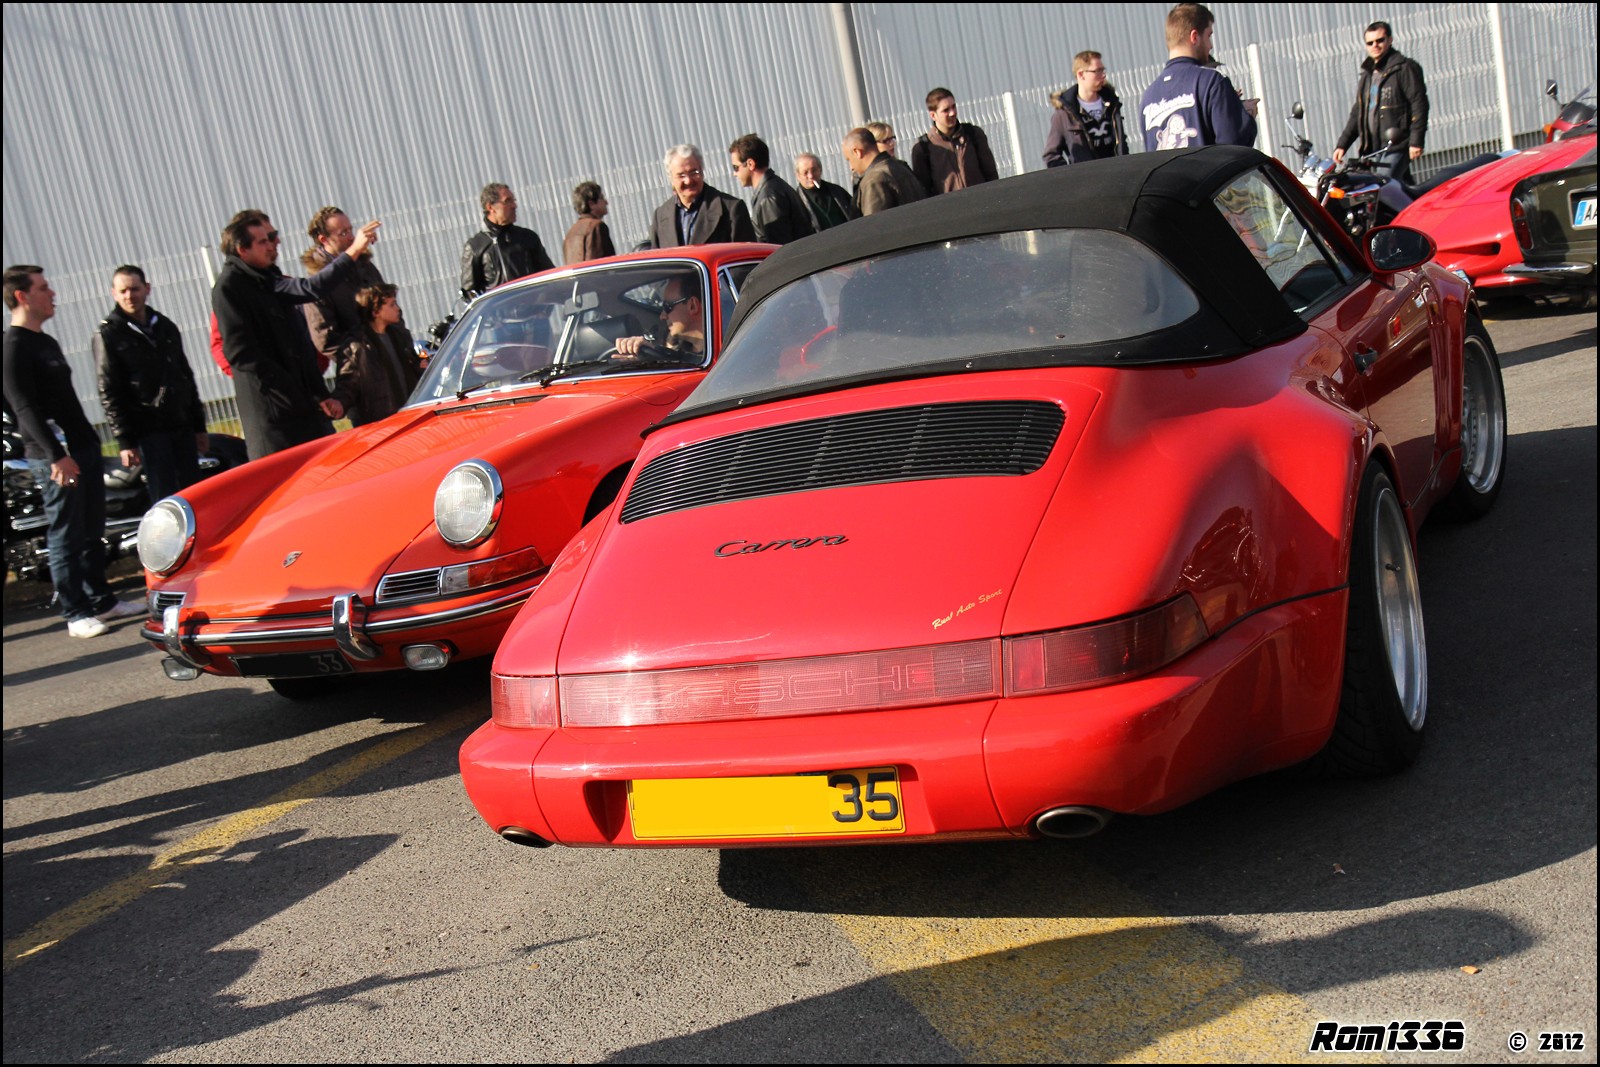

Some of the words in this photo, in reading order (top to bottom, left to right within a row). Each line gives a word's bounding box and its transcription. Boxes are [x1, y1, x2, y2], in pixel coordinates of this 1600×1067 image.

[714, 535, 849, 557] Carrera
[309, 653, 344, 673] 33
[828, 772, 899, 823] 35
